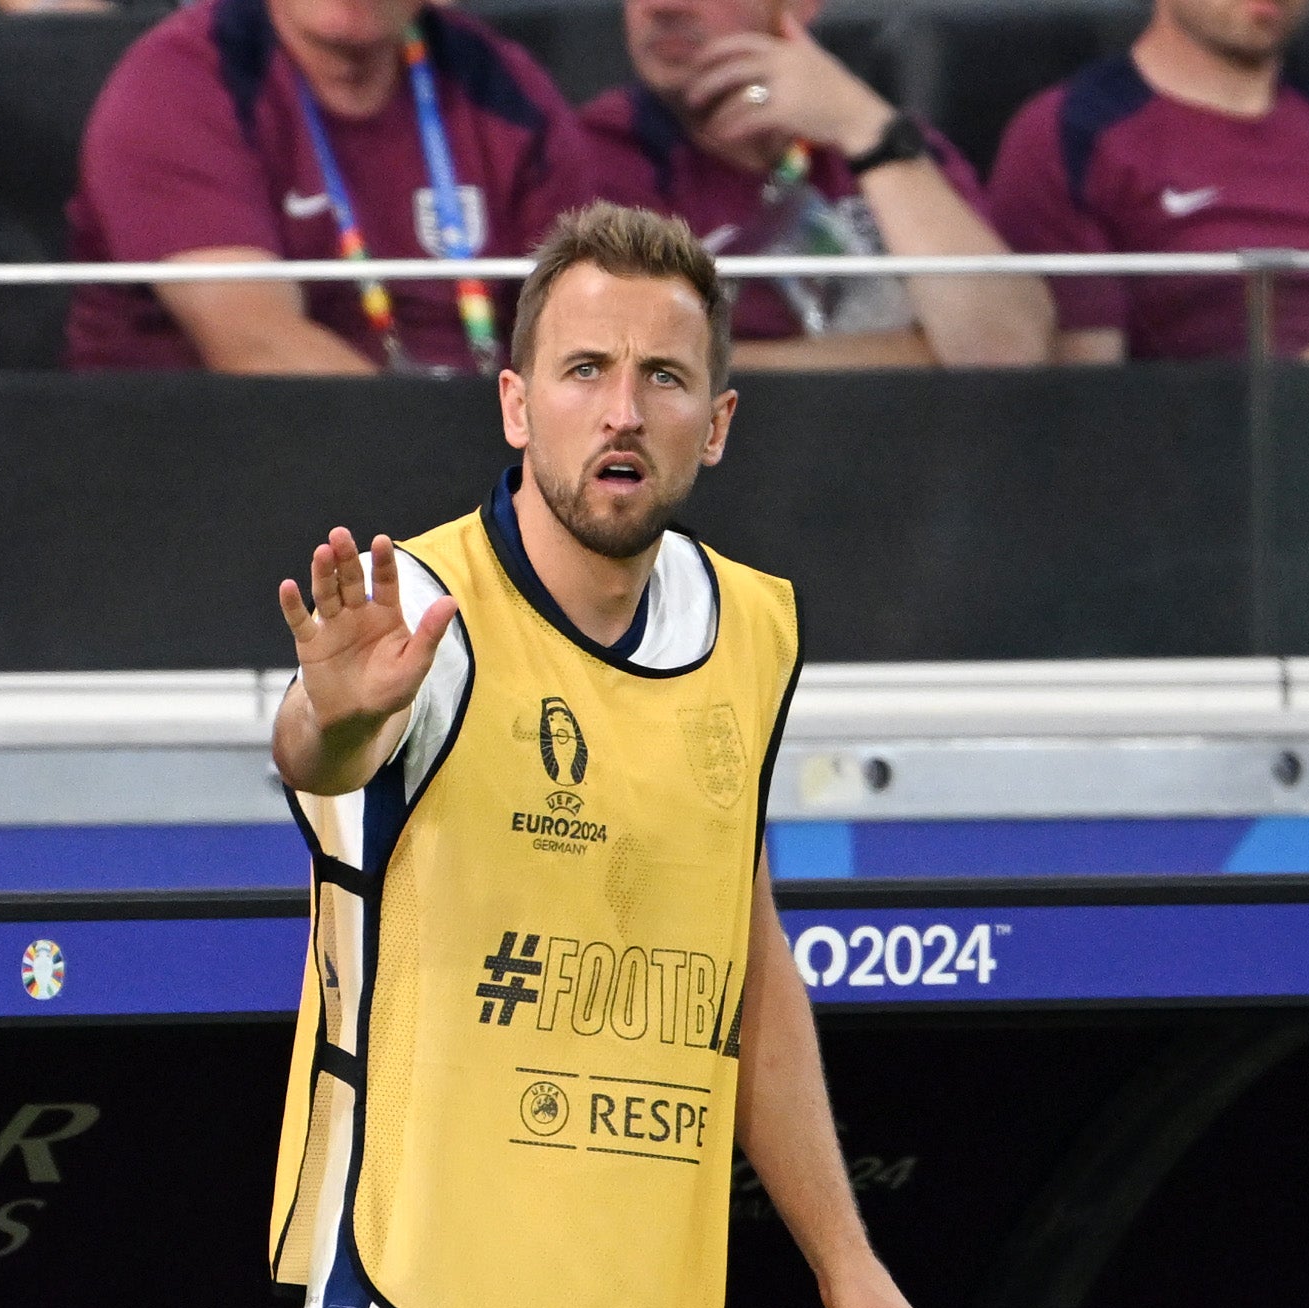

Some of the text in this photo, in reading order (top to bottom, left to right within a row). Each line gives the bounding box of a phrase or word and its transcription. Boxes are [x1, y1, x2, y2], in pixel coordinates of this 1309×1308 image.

[547, 794, 582, 814] UEFA
[512, 812, 607, 843] EURO2024
[533, 838, 588, 856] GERMANY
[531, 1085, 560, 1098] UEFA
